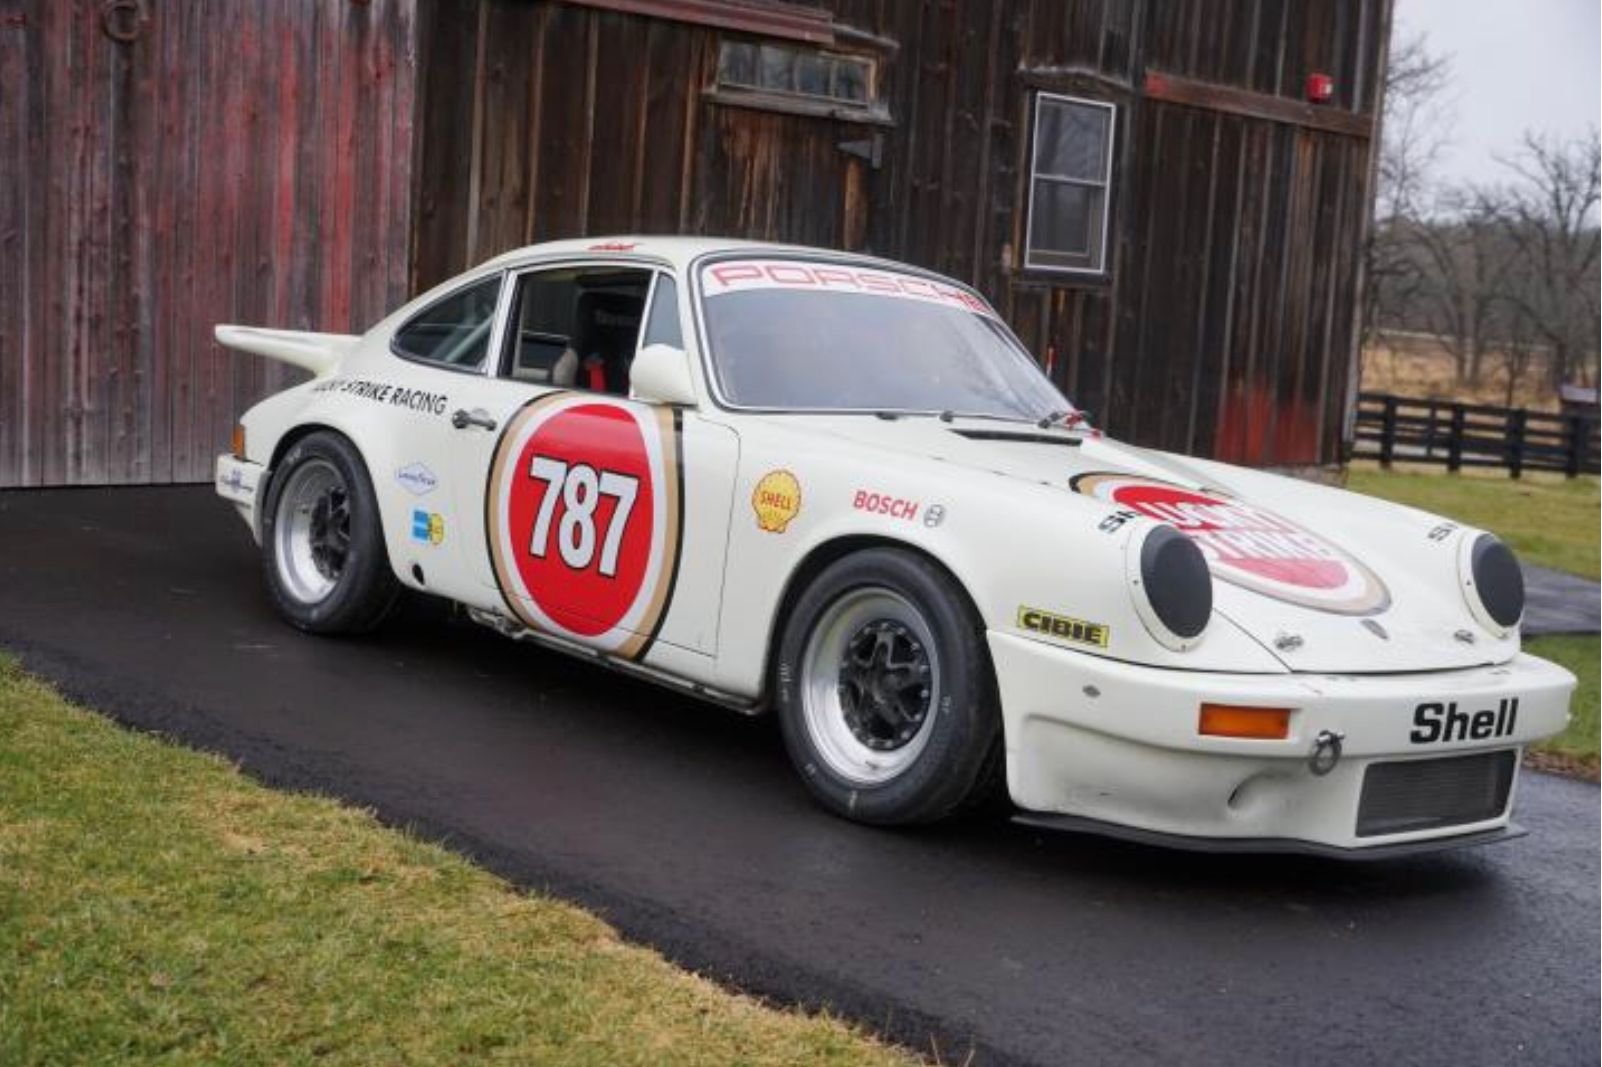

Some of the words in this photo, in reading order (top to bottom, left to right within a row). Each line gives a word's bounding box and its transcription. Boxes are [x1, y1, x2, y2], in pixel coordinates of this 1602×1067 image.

[712, 265, 992, 314] PORSCHE
[390, 387, 448, 415] RACING
[528, 453, 641, 581] 787
[759, 490, 791, 511] SHELL
[853, 490, 918, 521] BOSCH
[1409, 696, 1519, 745] Shell
